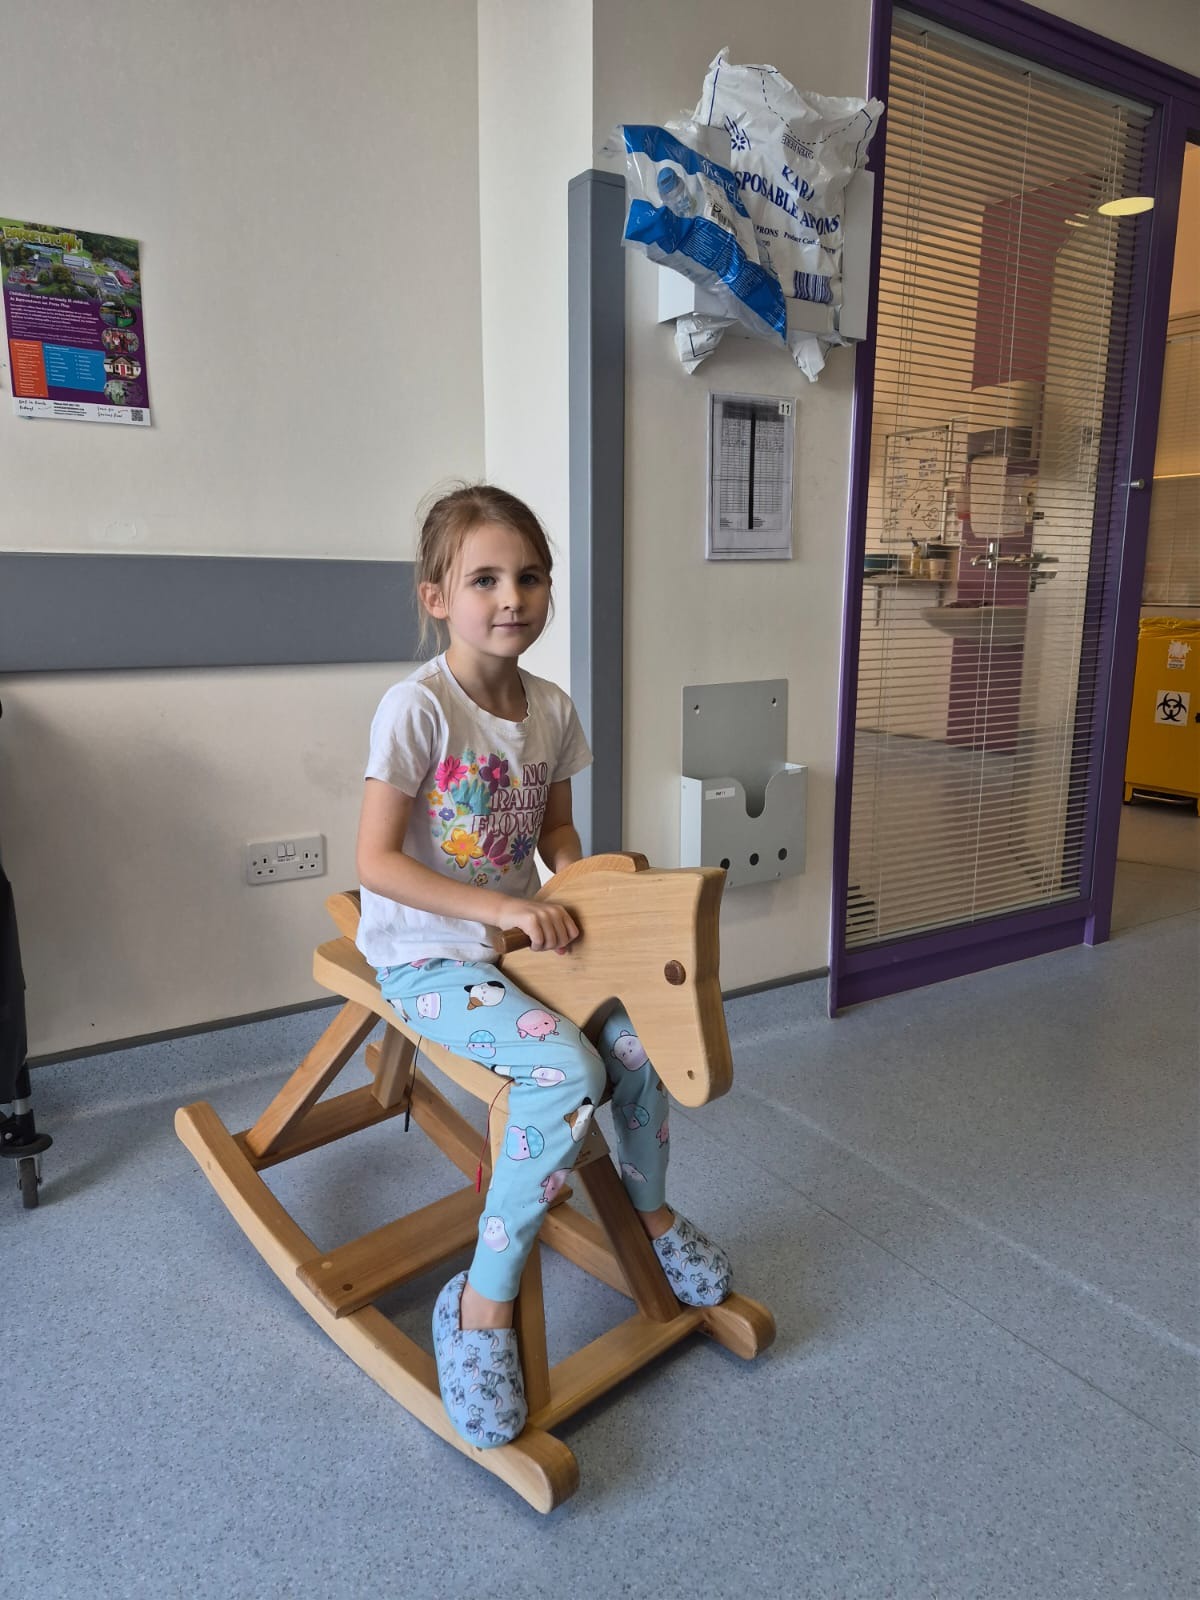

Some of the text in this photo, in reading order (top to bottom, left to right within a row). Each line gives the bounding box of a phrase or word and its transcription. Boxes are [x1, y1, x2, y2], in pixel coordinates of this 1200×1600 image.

[734, 170, 799, 219] SPOSABLE
[800, 210, 840, 236] APONS
[523, 762, 548, 786] NO
